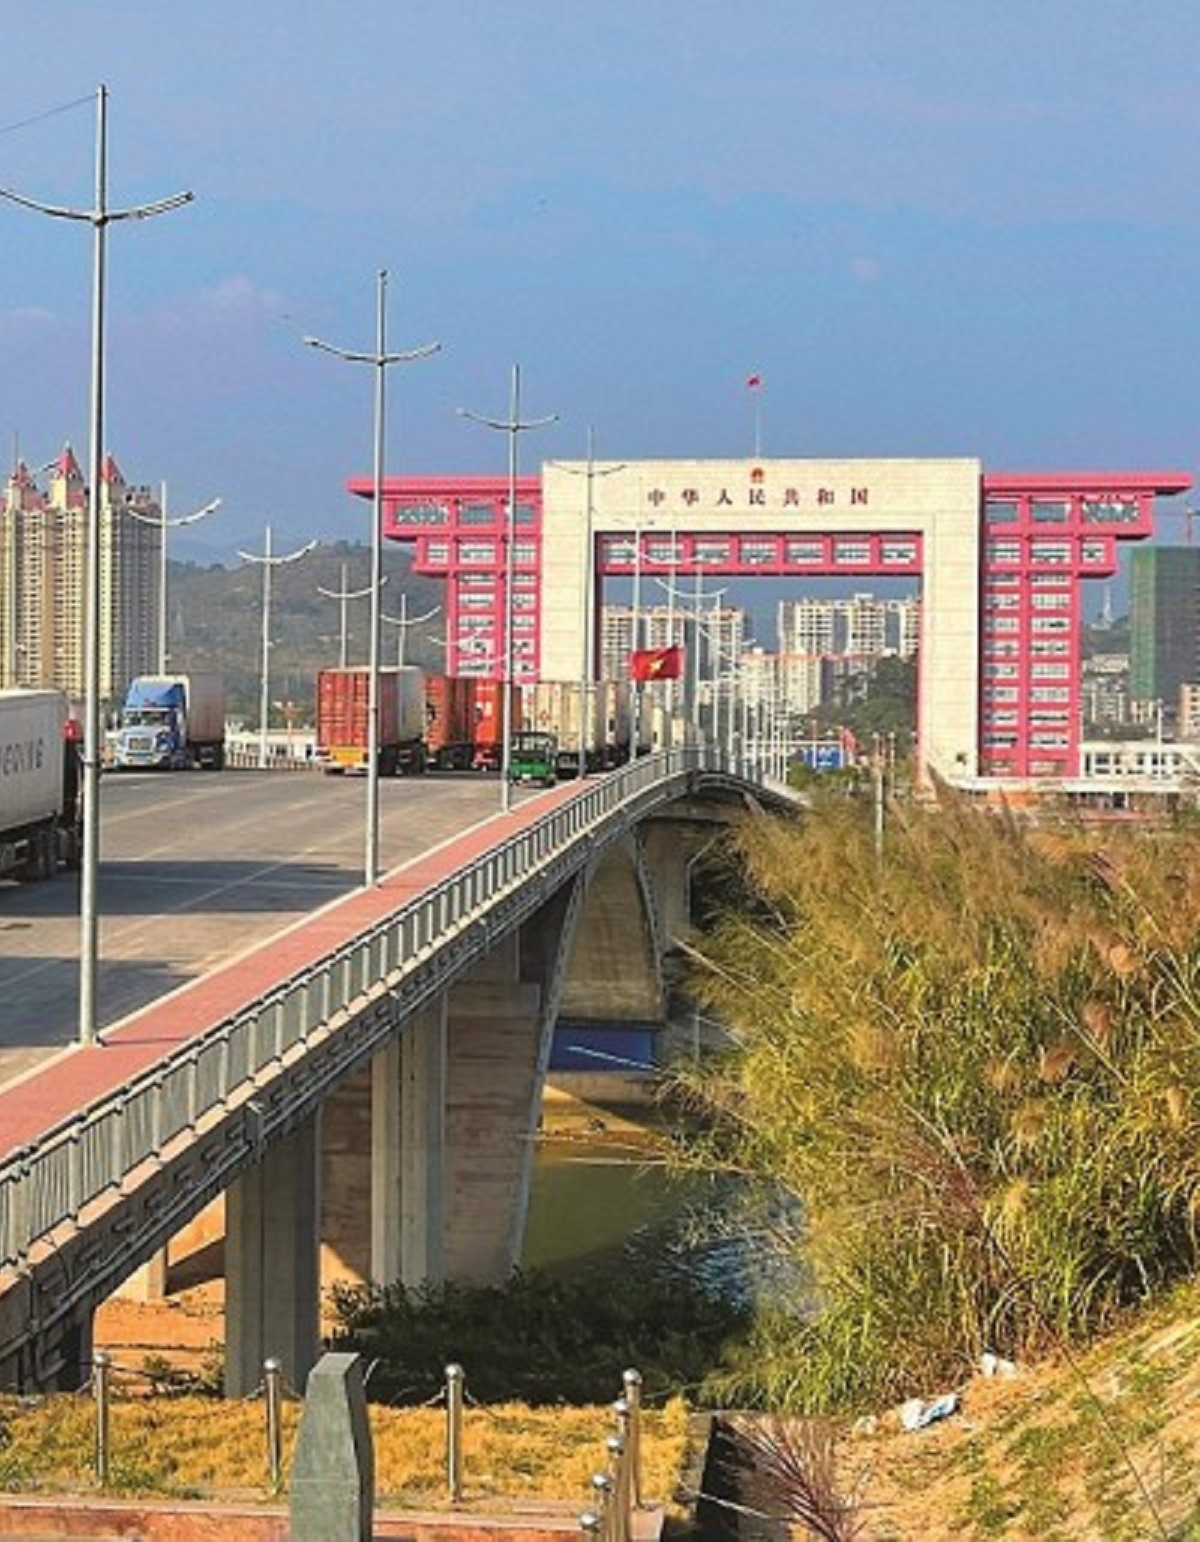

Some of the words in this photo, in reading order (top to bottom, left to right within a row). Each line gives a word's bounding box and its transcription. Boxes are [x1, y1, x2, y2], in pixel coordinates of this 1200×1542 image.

[647, 487, 870, 507] 中华人民共和国
